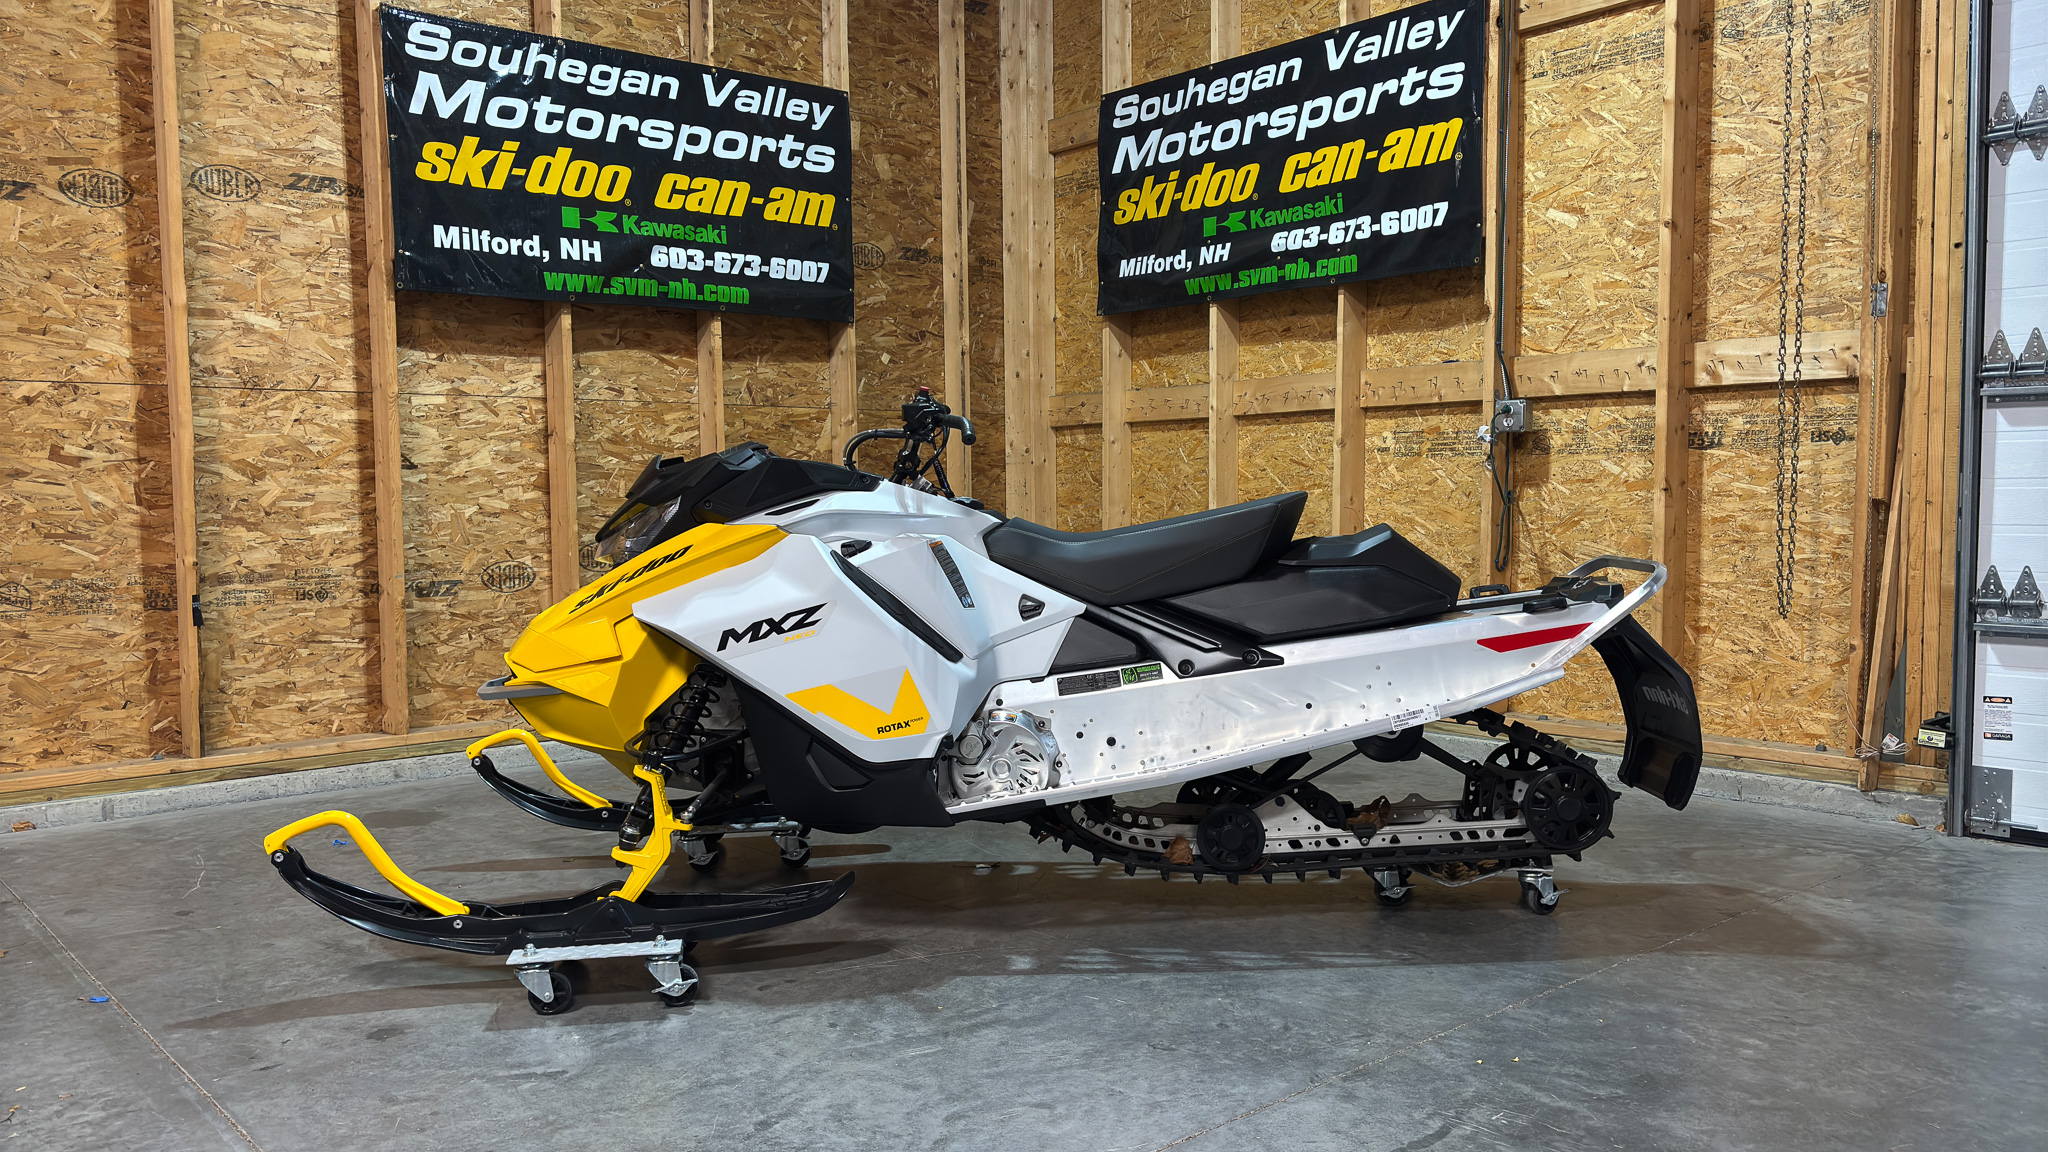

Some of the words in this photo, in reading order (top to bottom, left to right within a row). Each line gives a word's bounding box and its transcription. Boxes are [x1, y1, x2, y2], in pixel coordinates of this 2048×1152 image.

[404, 21, 680, 100] Souhegan
[702, 73, 835, 131] Valley
[1112, 57, 1303, 129] Souhegan
[1324, 9, 1465, 71] Valley
[408, 71, 837, 173] Motorsports
[1111, 62, 1466, 174] Motorsports
[199, 168, 256, 199] HUBER
[415, 136, 632, 202] ski-doo
[654, 173, 837, 228] can-am
[1113, 163, 1260, 225] ski-doo
[1278, 117, 1464, 194] can-am
[623, 215, 728, 245] Kawasaki
[1250, 193, 1344, 230] Kawasaki
[1270, 201, 1449, 253] 603-673-6007
[432, 225, 549, 263] Milford,
[560, 237, 602, 262] NH
[854, 246, 882, 267] HUBER
[1119, 249, 1193, 278] Milford,
[1199, 242, 1232, 267] NH
[650, 245, 830, 283] 603-673-6007
[1184, 252, 1358, 296] www.svm-nh.com
[543, 271, 750, 304] www.svm-nh.com
[717, 602, 828, 652] MXZ
[784, 629, 816, 642] NEO
[877, 720, 911, 734] ROTAX
